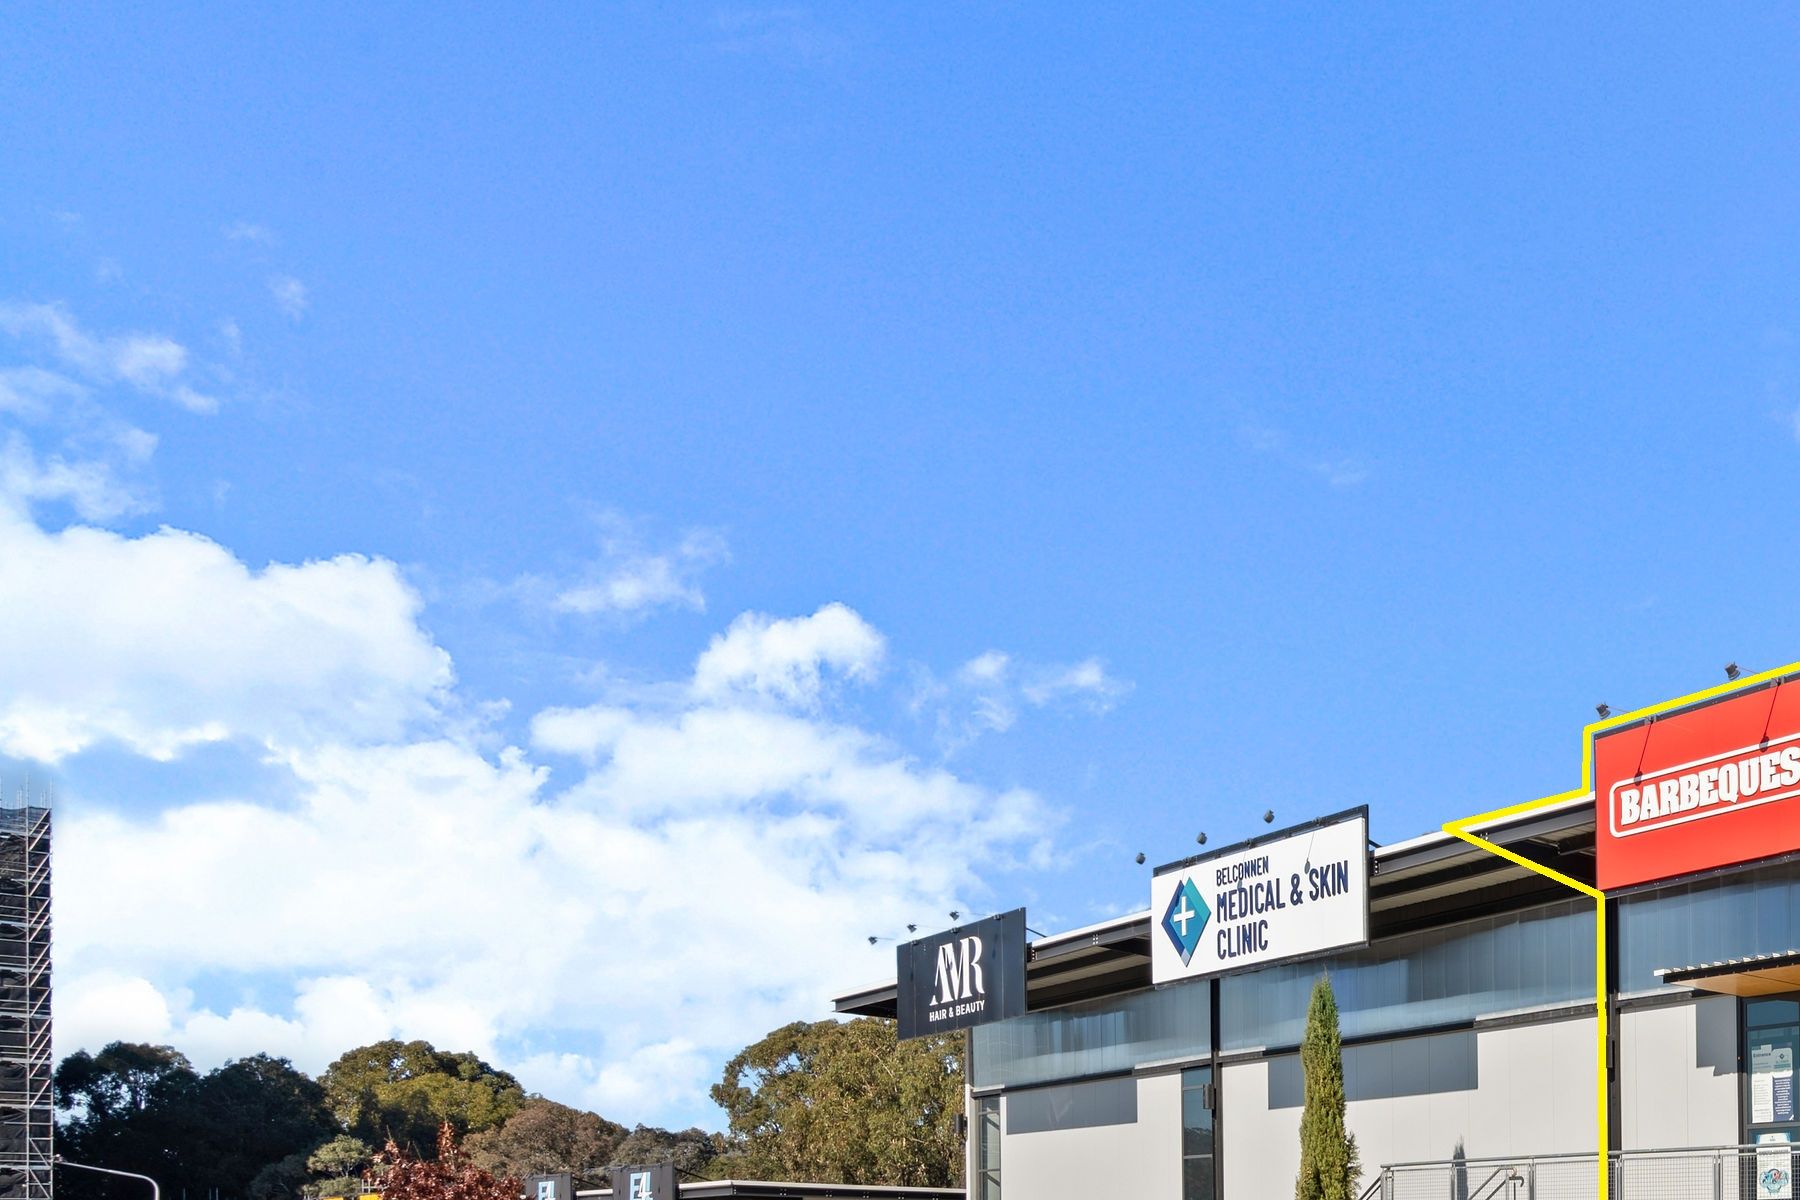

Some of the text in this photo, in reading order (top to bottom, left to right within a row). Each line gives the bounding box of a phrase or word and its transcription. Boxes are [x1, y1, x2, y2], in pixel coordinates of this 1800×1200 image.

[1620, 746, 1800, 826] BARBEQUES
[1216, 855, 1269, 887] BELCONNEN
[1216, 859, 1349, 924] MEDICAL & SKIN
[1216, 919, 1269, 961] CLINIC
[929, 1000, 985, 1022] HAIR & BEAUTY
